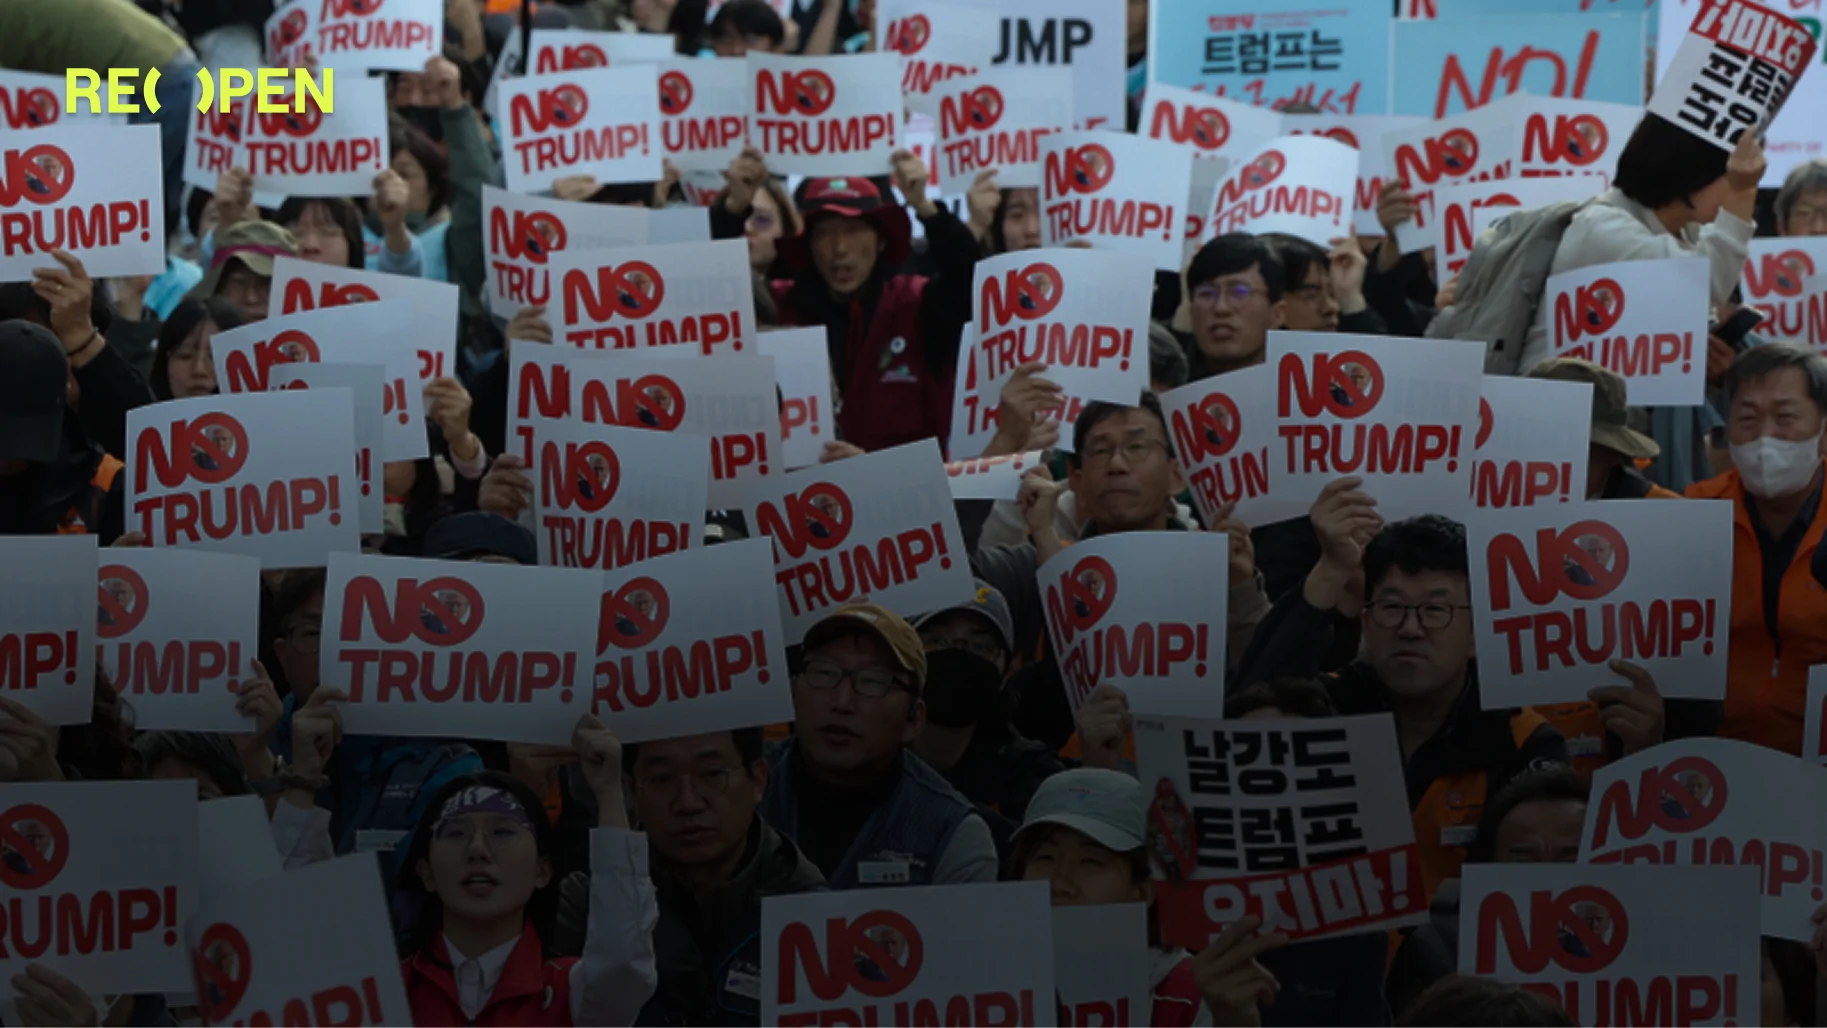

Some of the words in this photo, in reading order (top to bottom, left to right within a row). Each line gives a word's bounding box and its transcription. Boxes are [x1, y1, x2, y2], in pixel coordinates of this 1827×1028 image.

[319, 20, 433, 54] TRUMP!
[884, 14, 930, 55] NO
[1202, 30, 1343, 74] 트럼프는
[510, 83, 588, 137] NO
[756, 69, 835, 116] NO
[940, 85, 1004, 139] NO
[515, 122, 648, 174] TRUMP!
[757, 113, 895, 155] TRUMP!
[1150, 100, 1230, 149] NO
[1521, 113, 1608, 166] NO
[246, 137, 380, 176] TRUMP!
[1045, 143, 1114, 200] NO
[1215, 150, 1286, 214] NO
[1395, 128, 1478, 188] NO
[490, 206, 567, 264] NO
[1046, 198, 1173, 242] TRUMP!
[1213, 184, 1342, 237] TRUMP!
[563, 260, 664, 325] NO
[982, 262, 1064, 332] NO
[1554, 278, 1625, 348] NO
[982, 323, 1134, 381] TRUMP!
[582, 374, 685, 432] NO
[1279, 350, 1385, 418] NO
[135, 412, 248, 493] NO
[1172, 392, 1241, 468] NO
[1278, 425, 1461, 474] TRUMP!
[541, 441, 620, 512] NO
[1470, 462, 1571, 509] MP!
[134, 475, 340, 547] TRUMP!
[756, 482, 853, 564] NO
[543, 516, 690, 570] TRUMP!
[776, 523, 952, 617] TRUMP!
[1486, 520, 1630, 611] NO
[340, 575, 486, 648] NO
[1046, 556, 1118, 657] NO
[1063, 623, 1209, 709] TRUMP!
[1493, 599, 1716, 675] TRUMP!
[338, 650, 577, 705] TRUMP!
[1183, 728, 1357, 795] 날강도
[1591, 756, 1728, 851] NO
[1193, 802, 1367, 871] 트럼프
[777, 909, 924, 1005] NO
[1476, 885, 1628, 975] NO
